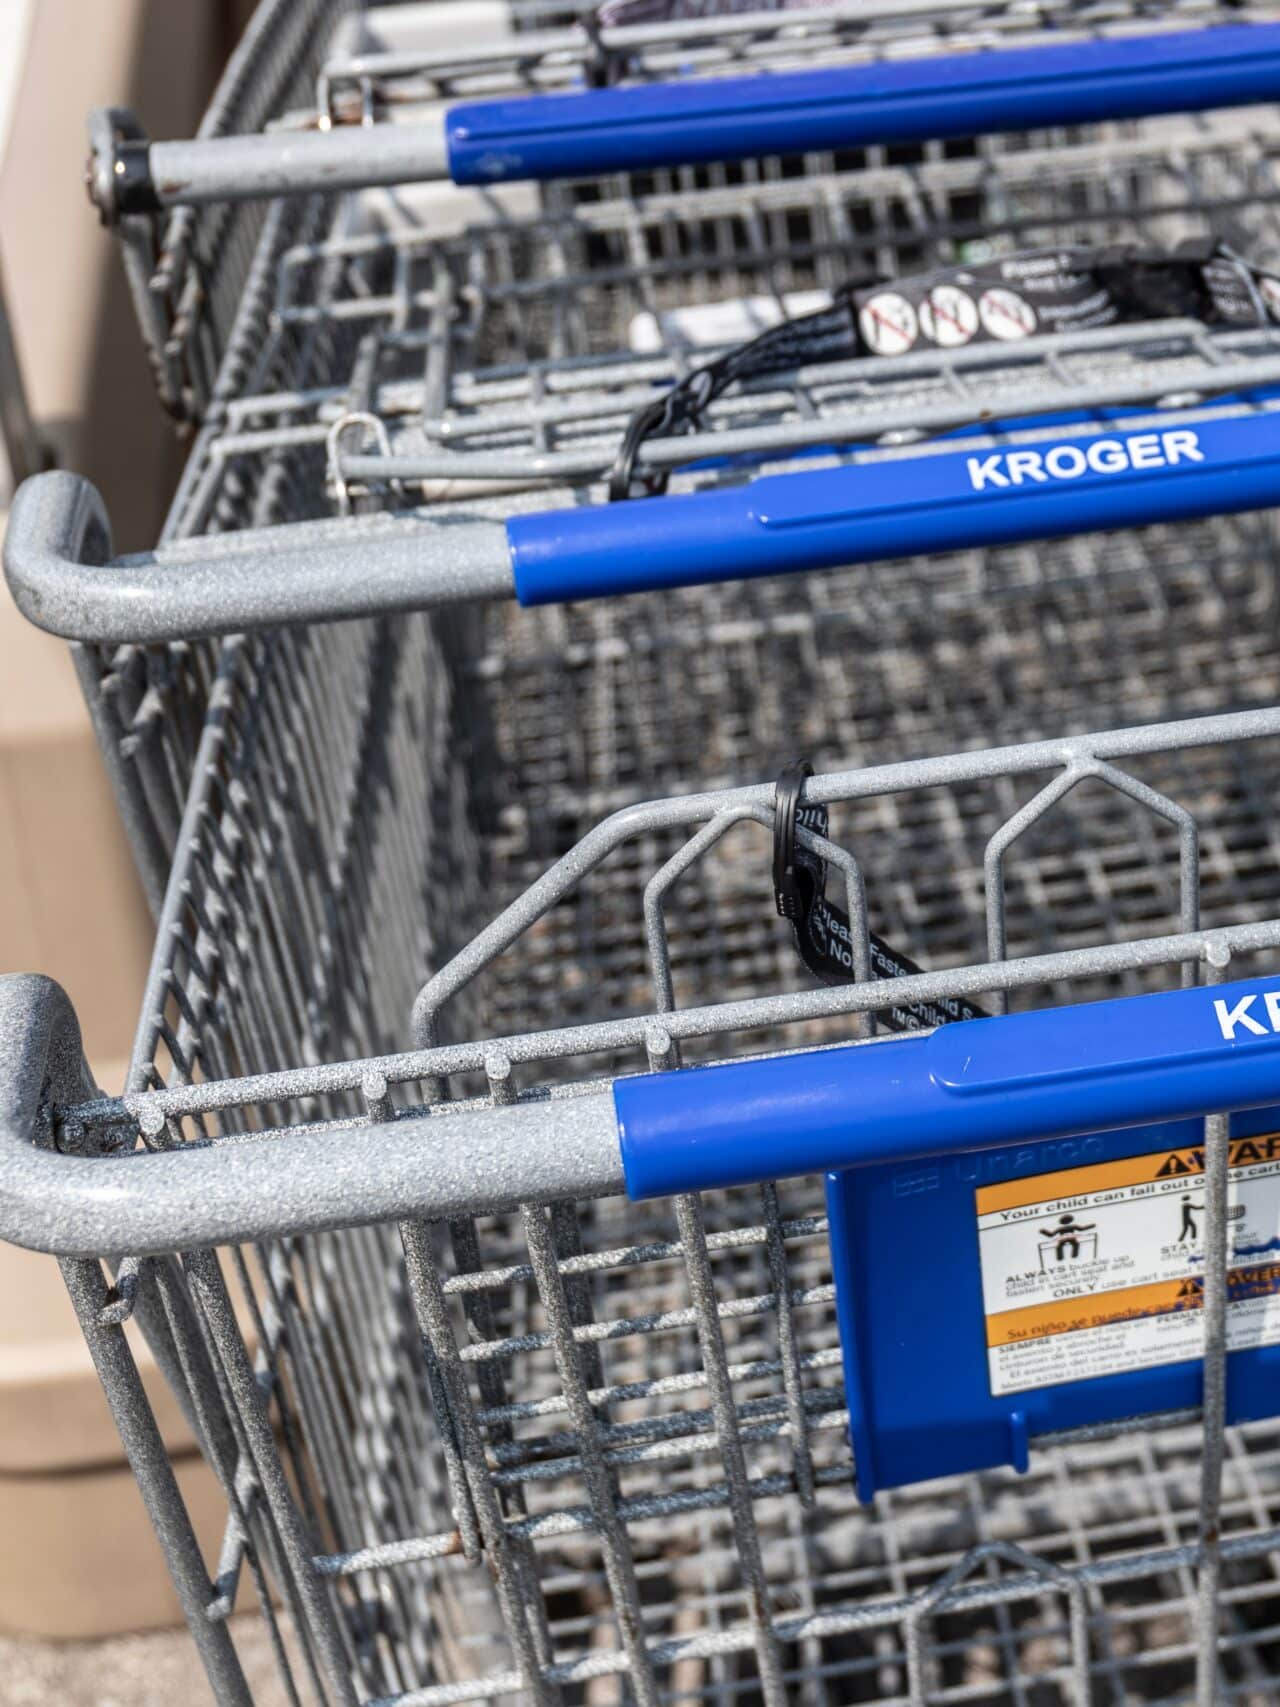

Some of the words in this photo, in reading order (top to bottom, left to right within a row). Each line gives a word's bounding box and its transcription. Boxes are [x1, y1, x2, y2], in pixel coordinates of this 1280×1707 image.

[966, 430, 1204, 490] KROGER
[869, 942, 908, 977] Faste
[1000, 1207, 1041, 1222] Your
[1046, 1196, 1089, 1213] child
[1093, 1191, 1125, 1204] can
[1130, 1184, 1156, 1197] fall
[1161, 1178, 1189, 1192] out
[1248, 1162, 1280, 1176] cart
[1005, 1265, 1067, 1284] ALWAYS
[1053, 1282, 1097, 1298] ONLY
[1007, 1328, 1028, 1339] Su
